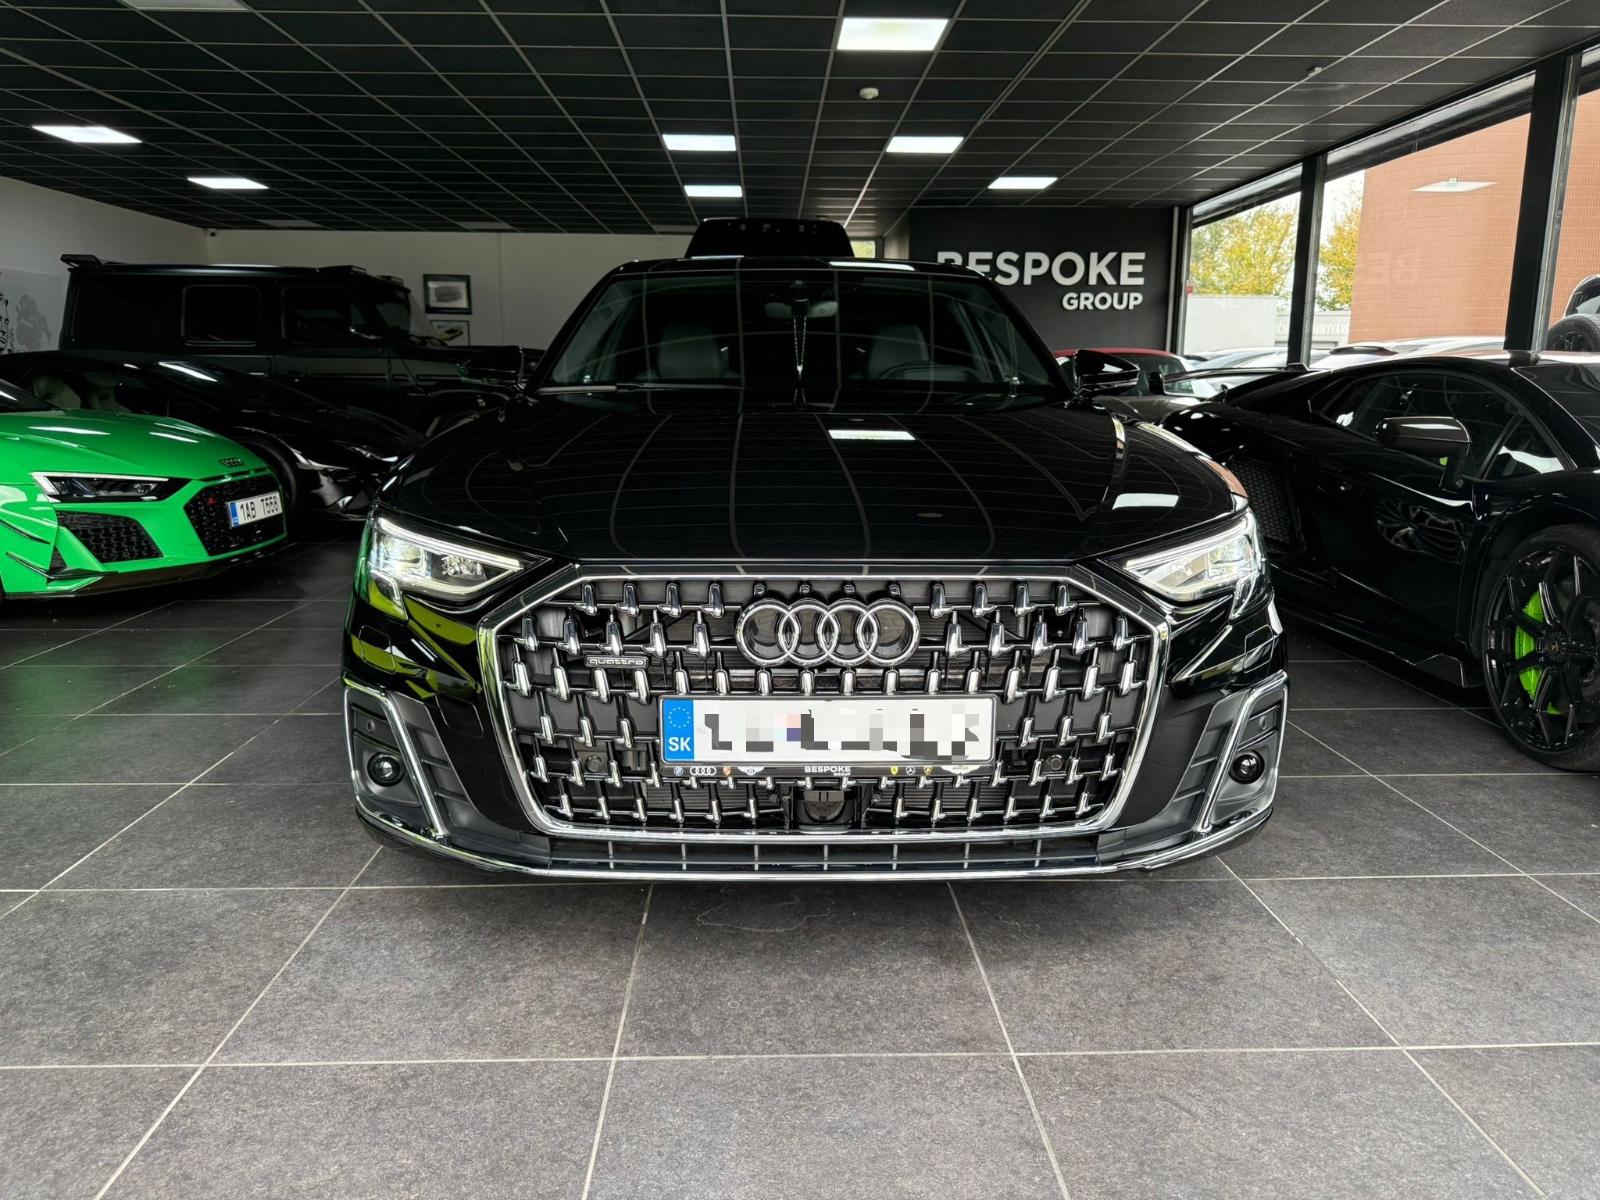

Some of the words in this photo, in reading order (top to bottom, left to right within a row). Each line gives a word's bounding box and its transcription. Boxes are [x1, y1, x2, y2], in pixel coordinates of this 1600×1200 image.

[1062, 292, 1143, 310] GROUP
[240, 501, 256, 521] 1AB
[589, 658, 644, 666] quattro
[668, 737, 692, 752] SK
[804, 765, 851, 773] BESPOKE
